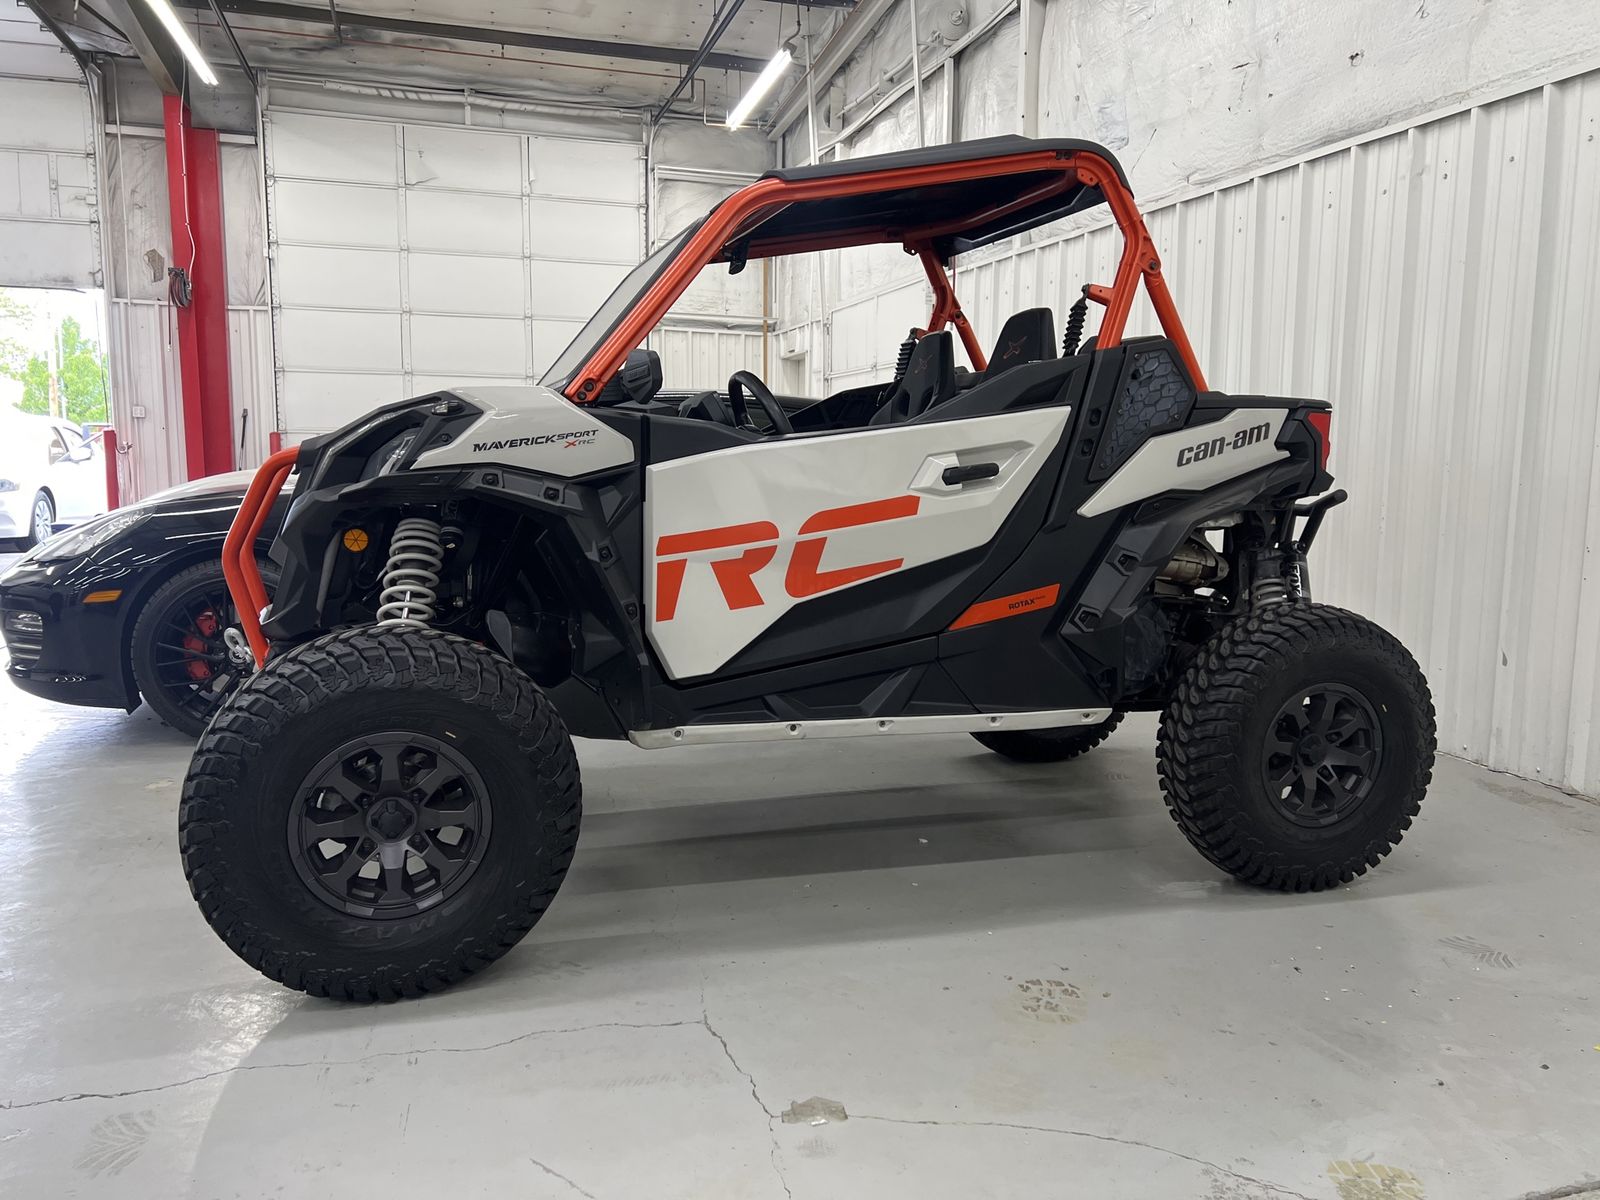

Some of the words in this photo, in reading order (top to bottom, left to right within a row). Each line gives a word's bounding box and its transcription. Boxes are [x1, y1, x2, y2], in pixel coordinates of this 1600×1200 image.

[473, 434, 557, 452] MAVERICK
[556, 429, 599, 440] SPORT
[1176, 422, 1271, 467] can-am
[655, 494, 921, 623] RC
[1290, 563, 1303, 598] FOX
[1008, 599, 1036, 610] ROTAX
